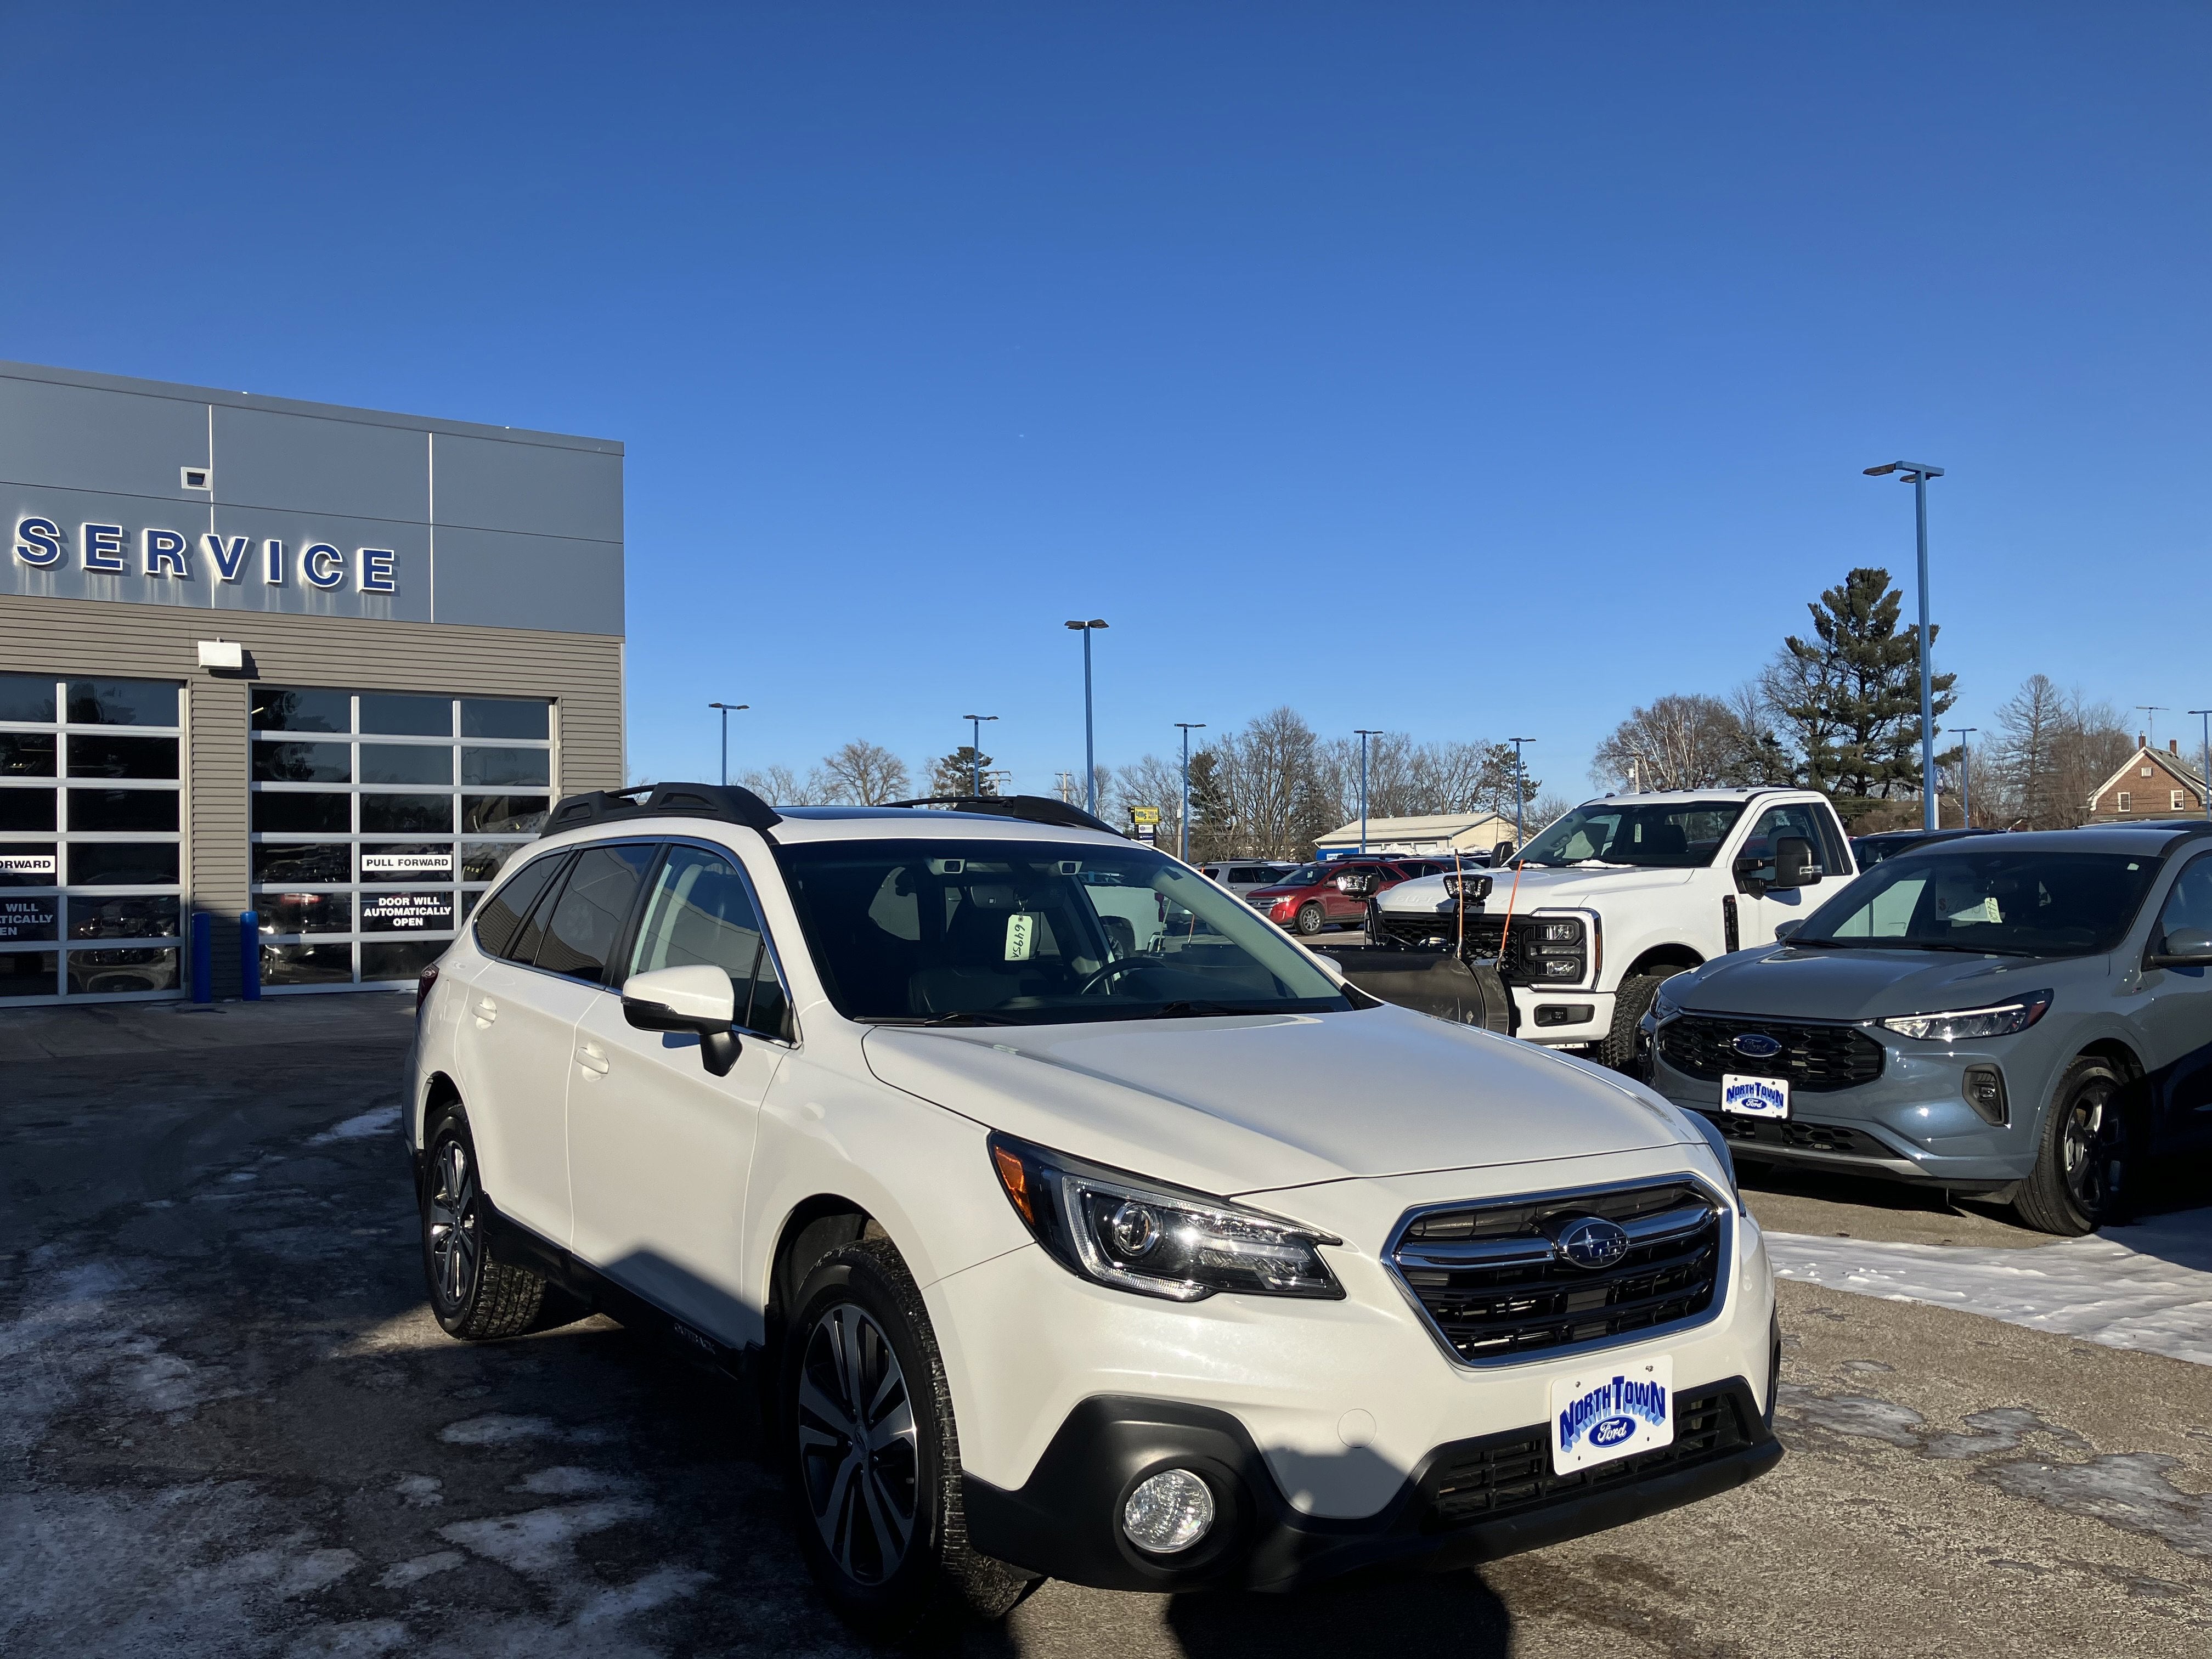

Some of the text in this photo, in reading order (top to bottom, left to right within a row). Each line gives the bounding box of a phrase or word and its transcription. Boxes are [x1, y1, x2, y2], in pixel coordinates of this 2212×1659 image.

[14, 517, 396, 592] SERVICE
[366, 859, 449, 867] PULL FORWARD
[379, 896, 440, 906] DOOR WILL
[5, 903, 39, 912] WILL
[364, 906, 452, 917] AUTOMATICALLY
[0, 914, 53, 924] TICALLY
[393, 917, 424, 927] OPEN
[1742, 1039, 1768, 1052] Ford
[1746, 1098, 1762, 1108] Ford
[1597, 1420, 1627, 1443] Ford
